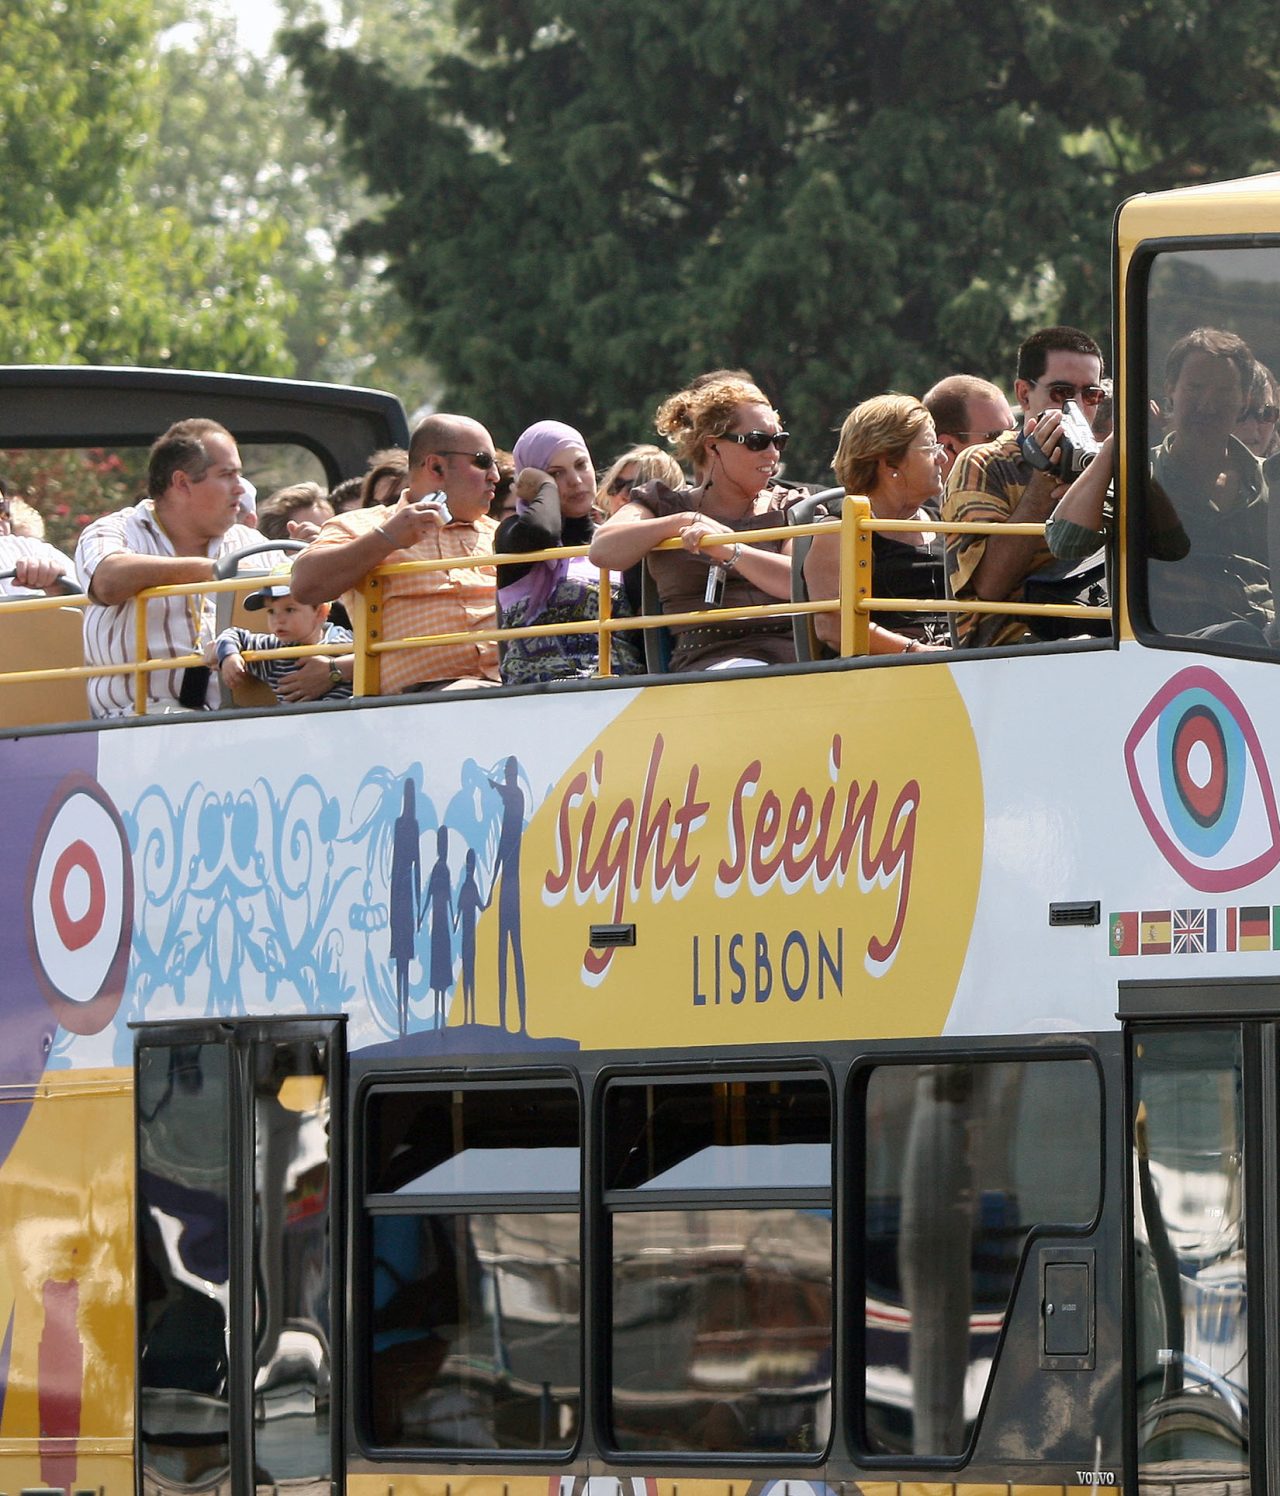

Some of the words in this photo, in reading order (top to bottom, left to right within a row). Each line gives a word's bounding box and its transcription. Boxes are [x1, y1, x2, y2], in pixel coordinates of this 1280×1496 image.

[543, 732, 710, 978] Sight
[715, 733, 921, 970] Seeing
[692, 928, 844, 1006] LISBON
[1076, 1471, 1115, 1485] VOLVO
